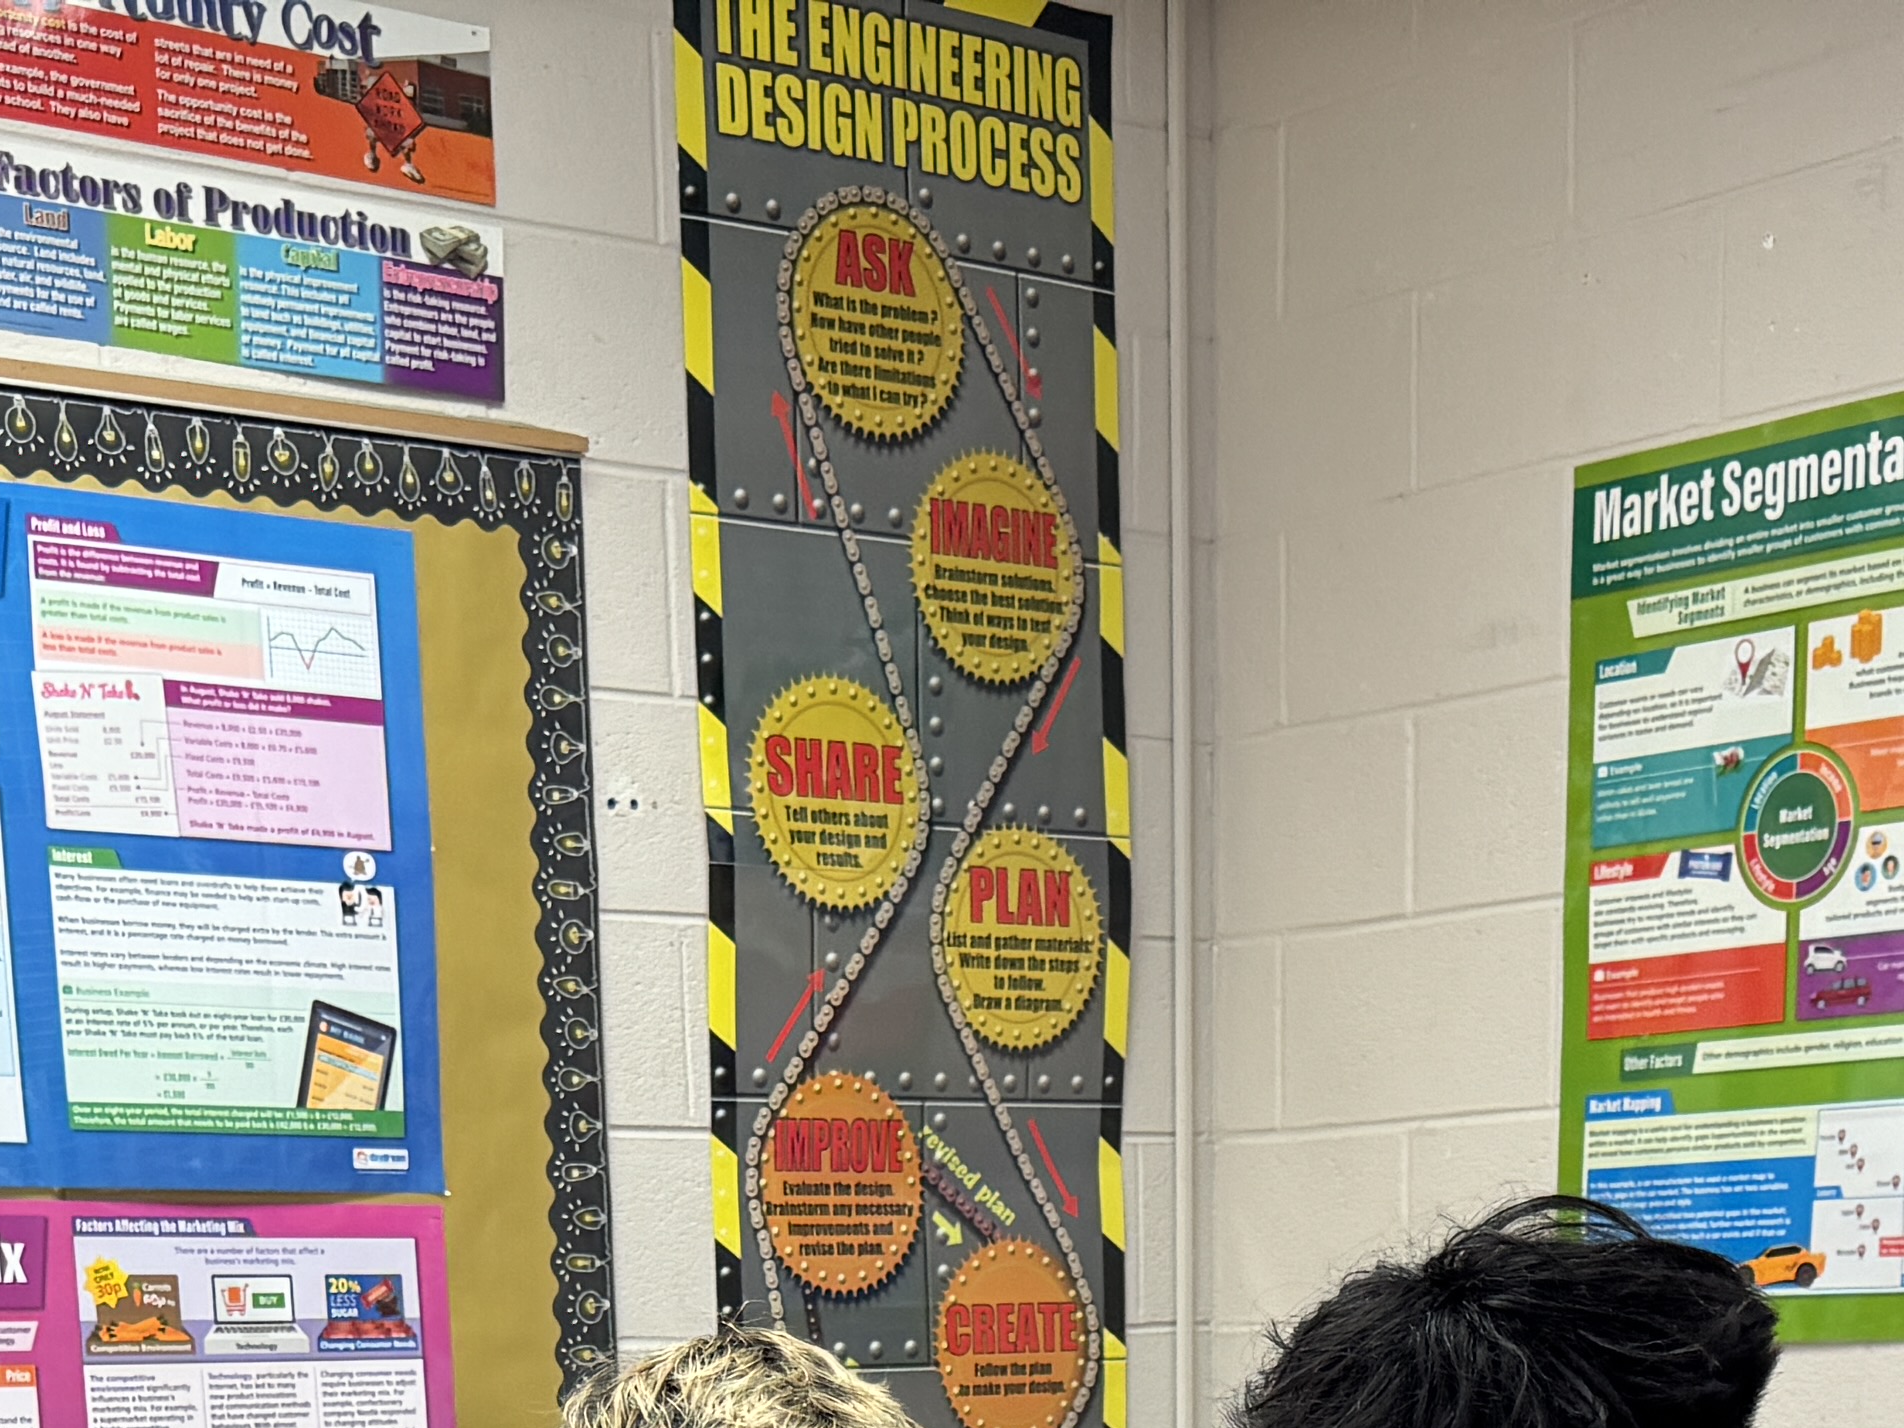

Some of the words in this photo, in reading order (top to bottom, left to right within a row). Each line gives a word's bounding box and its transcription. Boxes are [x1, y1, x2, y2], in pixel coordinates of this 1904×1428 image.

[281, 0, 389, 68] Cost
[714, 0, 799, 67] THE
[808, 0, 1082, 129] ENGINEERING
[715, 61, 884, 164] DESIGN
[891, 96, 1082, 205] PROCESS
[23, 202, 70, 232] Land
[143, 222, 197, 252] Labor
[153, 183, 193, 224] of
[202, 185, 412, 259] Production
[834, 227, 917, 299] ASK
[929, 496, 1060, 571] IMAGINE
[1592, 467, 1717, 545] Market
[1599, 659, 1637, 678] Location
[764, 733, 905, 806] SHARE
[968, 865, 1071, 928] PLAN
[773, 1118, 904, 1174] IMPROVE
[916, 1123, 984, 1191] revised
[971, 1184, 1017, 1229] plan
[258, 1294, 280, 1307] BUY
[327, 1276, 362, 1295] 20%
[946, 1302, 1080, 1356] CREATE
